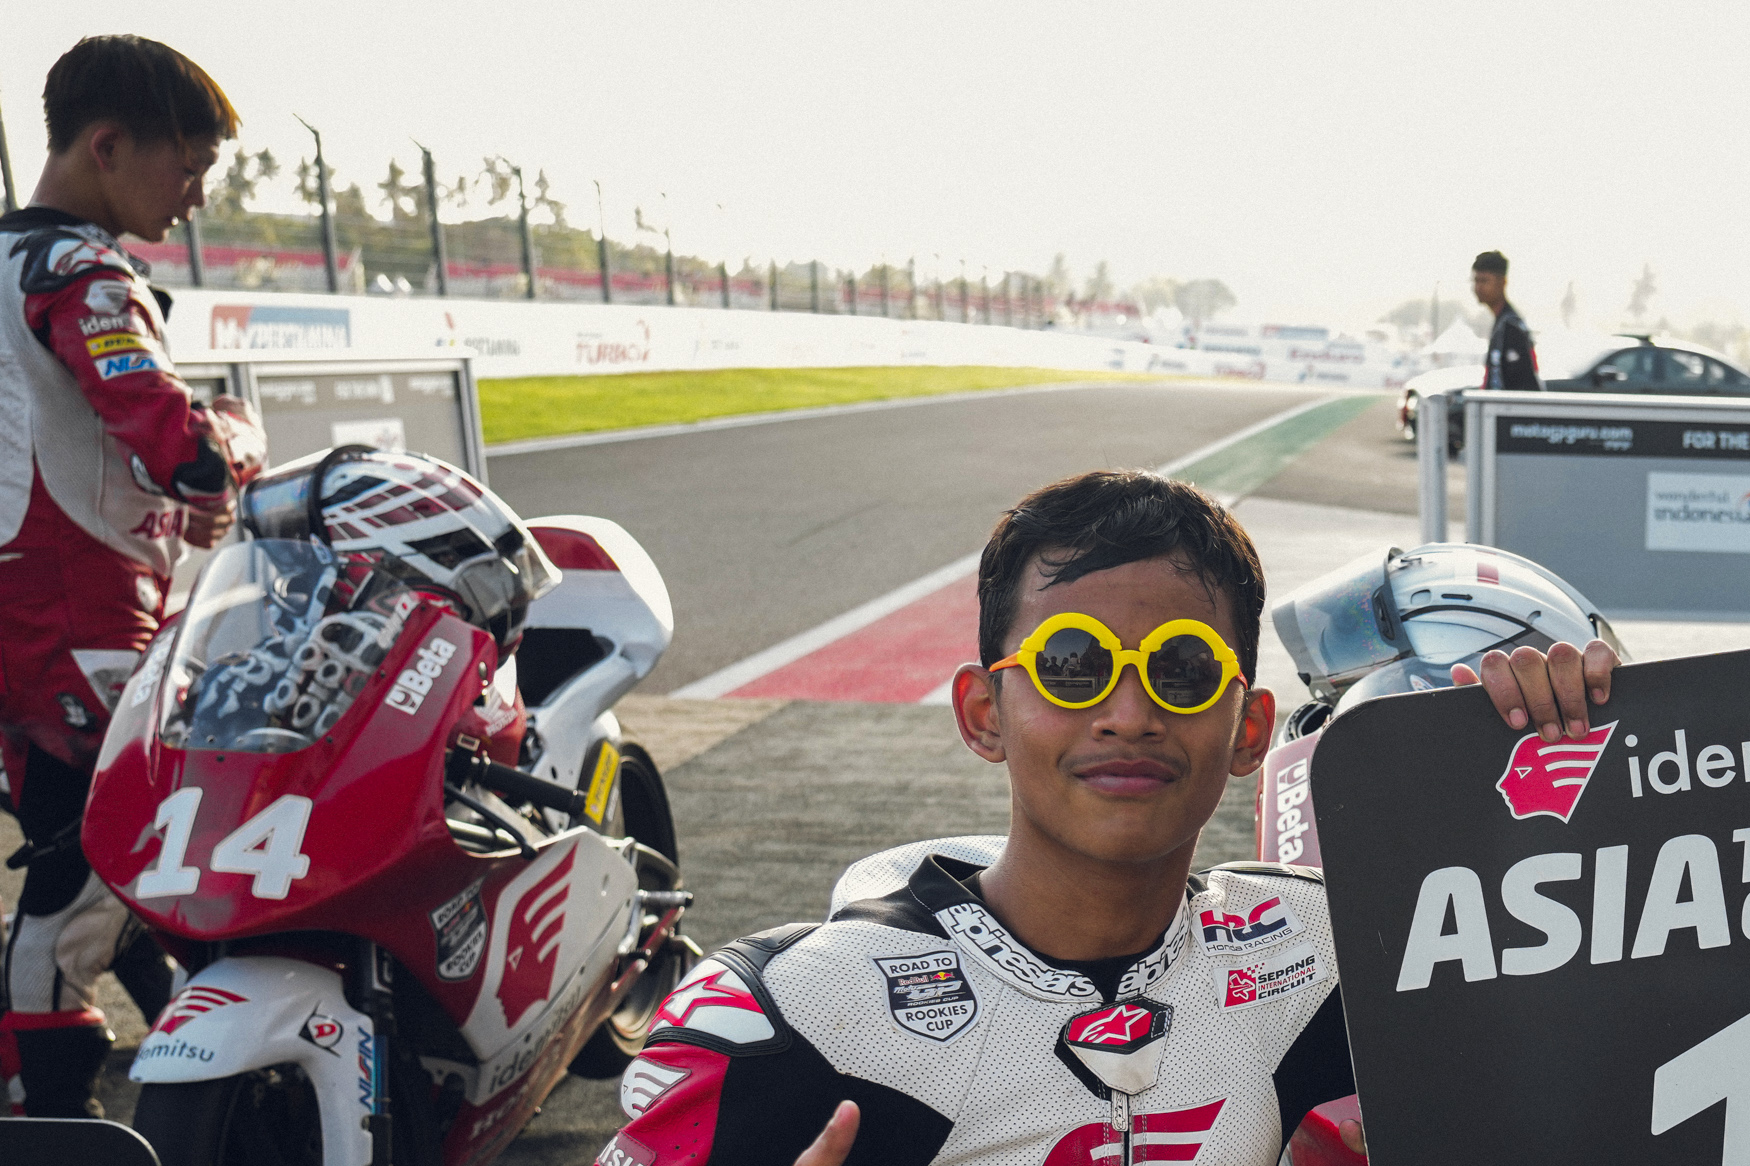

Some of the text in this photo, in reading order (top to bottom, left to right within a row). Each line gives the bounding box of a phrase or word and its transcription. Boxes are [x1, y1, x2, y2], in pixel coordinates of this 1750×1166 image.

[1682, 430, 1716, 451] FOR
[1719, 431, 1749, 451] THE
[398, 637, 458, 702] Beta
[1276, 785, 1309, 865] Beta
[135, 786, 313, 900] 14
[1396, 833, 1732, 993] ASIA
[1206, 926, 1294, 953] Honda RACING
[889, 957, 953, 975] ROAD TO
[1257, 954, 1316, 985] SEPANG
[1257, 965, 1317, 992] INTERNATIONAL
[1257, 971, 1317, 1000] CIRCUIT
[905, 1004, 968, 1023] ROOKIES
[926, 1018, 954, 1033] CUP
